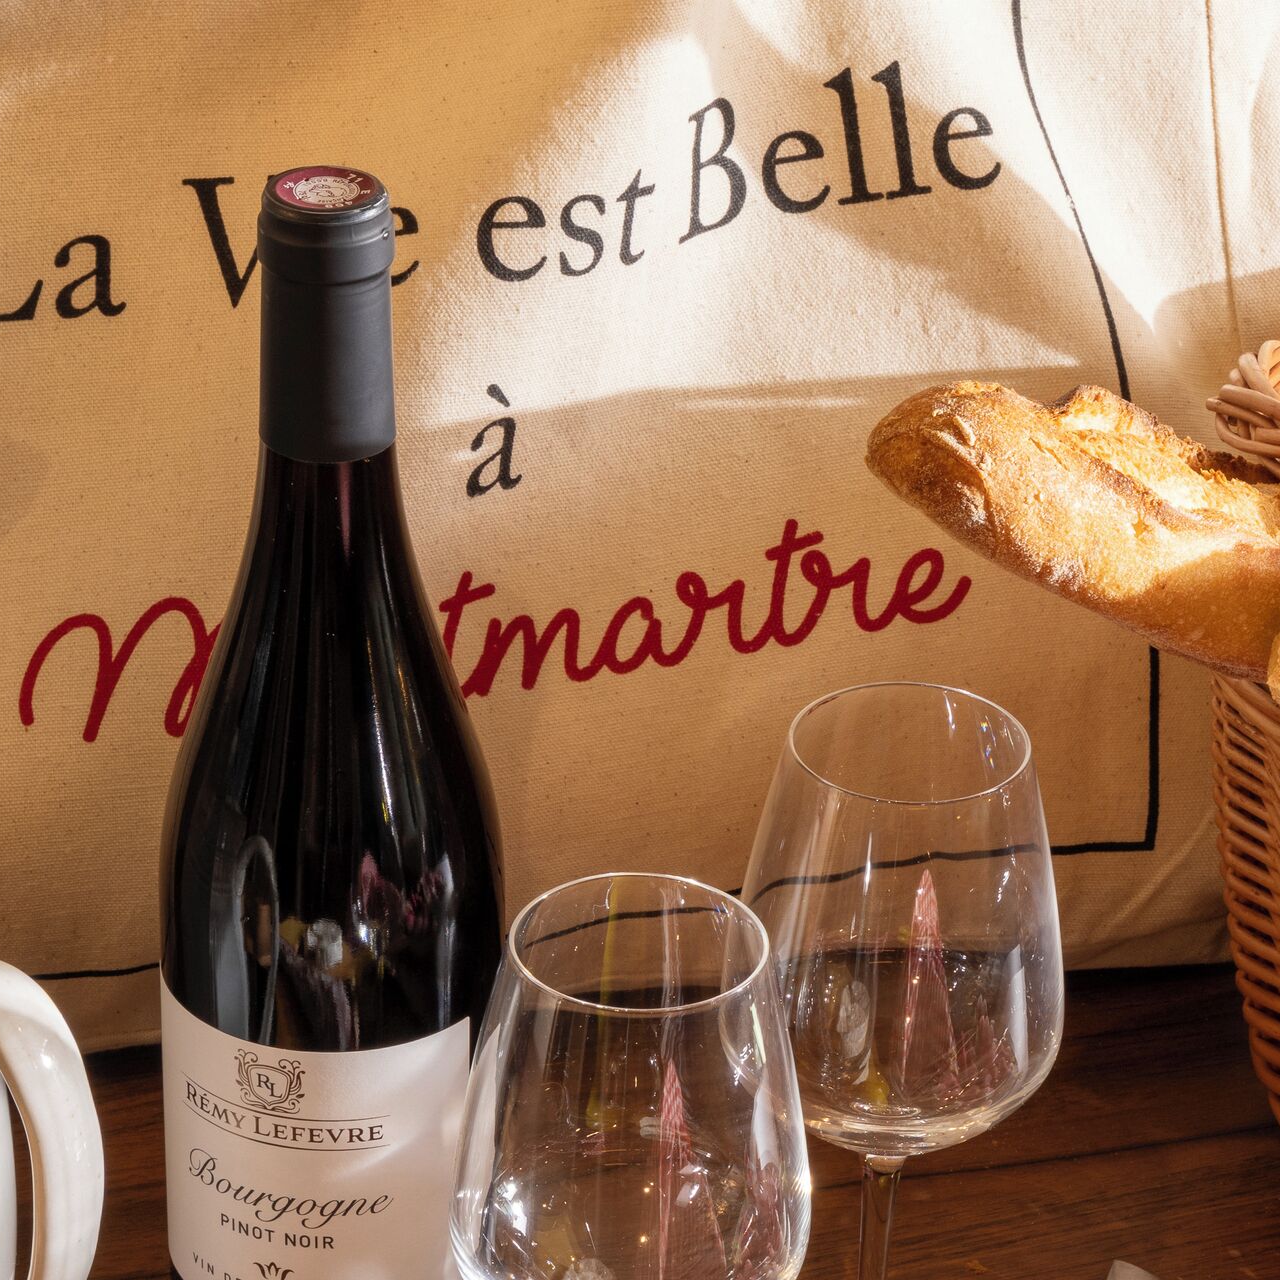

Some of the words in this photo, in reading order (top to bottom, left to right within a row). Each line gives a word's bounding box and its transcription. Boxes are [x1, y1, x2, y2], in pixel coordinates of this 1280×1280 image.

[476, 168, 654, 284] est
[677, 60, 1004, 246] Belle
[464, 383, 522, 499] à
[18, 517, 972, 744] Mtmartre
[185, 1081, 246, 1129] RÉMY
[253, 1116, 384, 1144] LEFEVRE
[188, 1147, 394, 1230] Bourgogne
[192, 1252, 215, 1275] VIN
[220, 1213, 275, 1242] PINOT
[284, 1232, 335, 1249] NOIR
